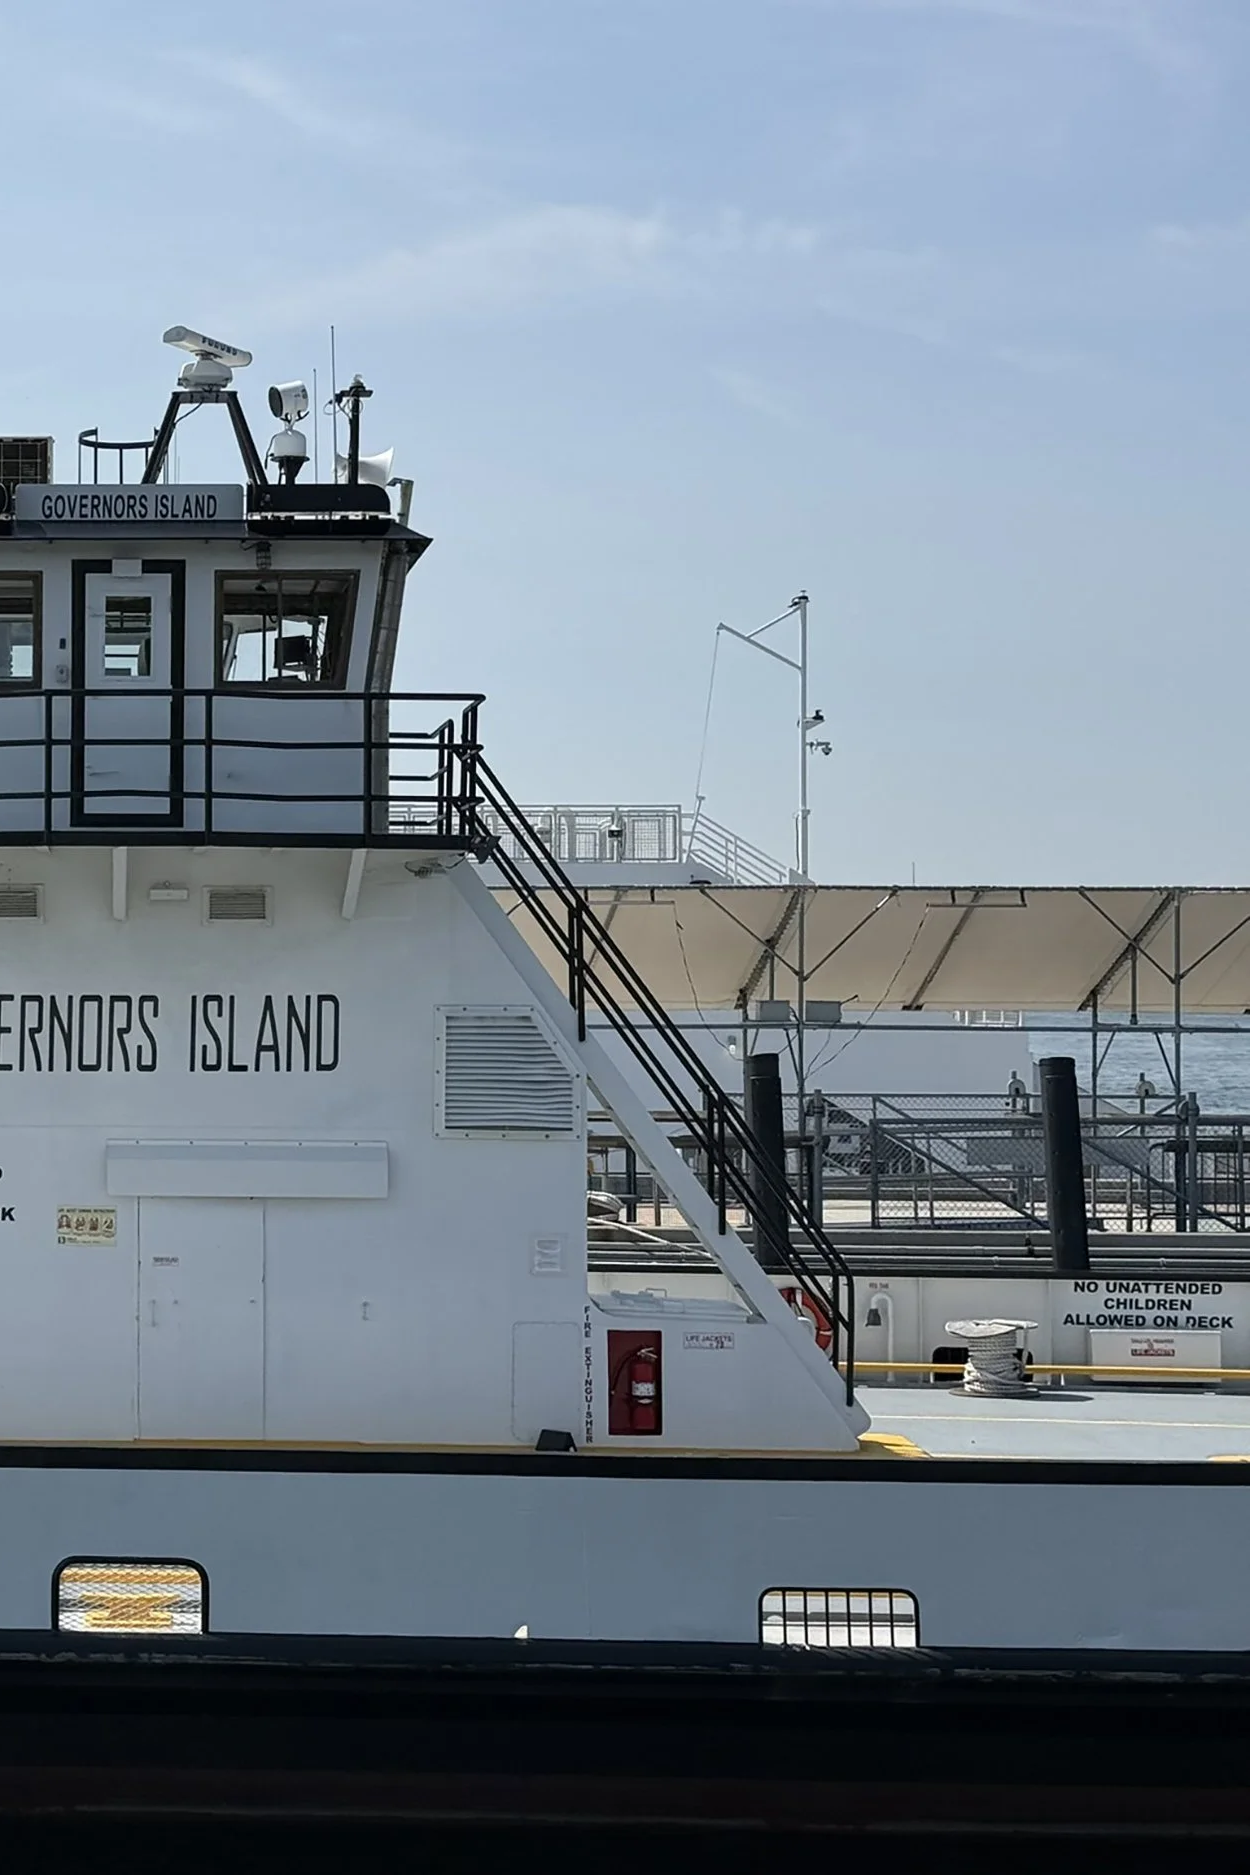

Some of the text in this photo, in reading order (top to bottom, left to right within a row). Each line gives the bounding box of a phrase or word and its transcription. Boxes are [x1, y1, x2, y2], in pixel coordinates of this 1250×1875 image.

[201, 336, 238, 356] FURUNO
[41, 495, 217, 518] GOVERNORS ISLAND
[190, 994, 340, 1072] ISLAND
[1073, 1281, 1223, 1295] NO UNATTENDED
[1103, 1297, 1192, 1311] CHILDREN
[1062, 1313, 1234, 1329] ALLOWED ON DECK
[584, 1305, 594, 1443] FIRE EXTINGUISHER
